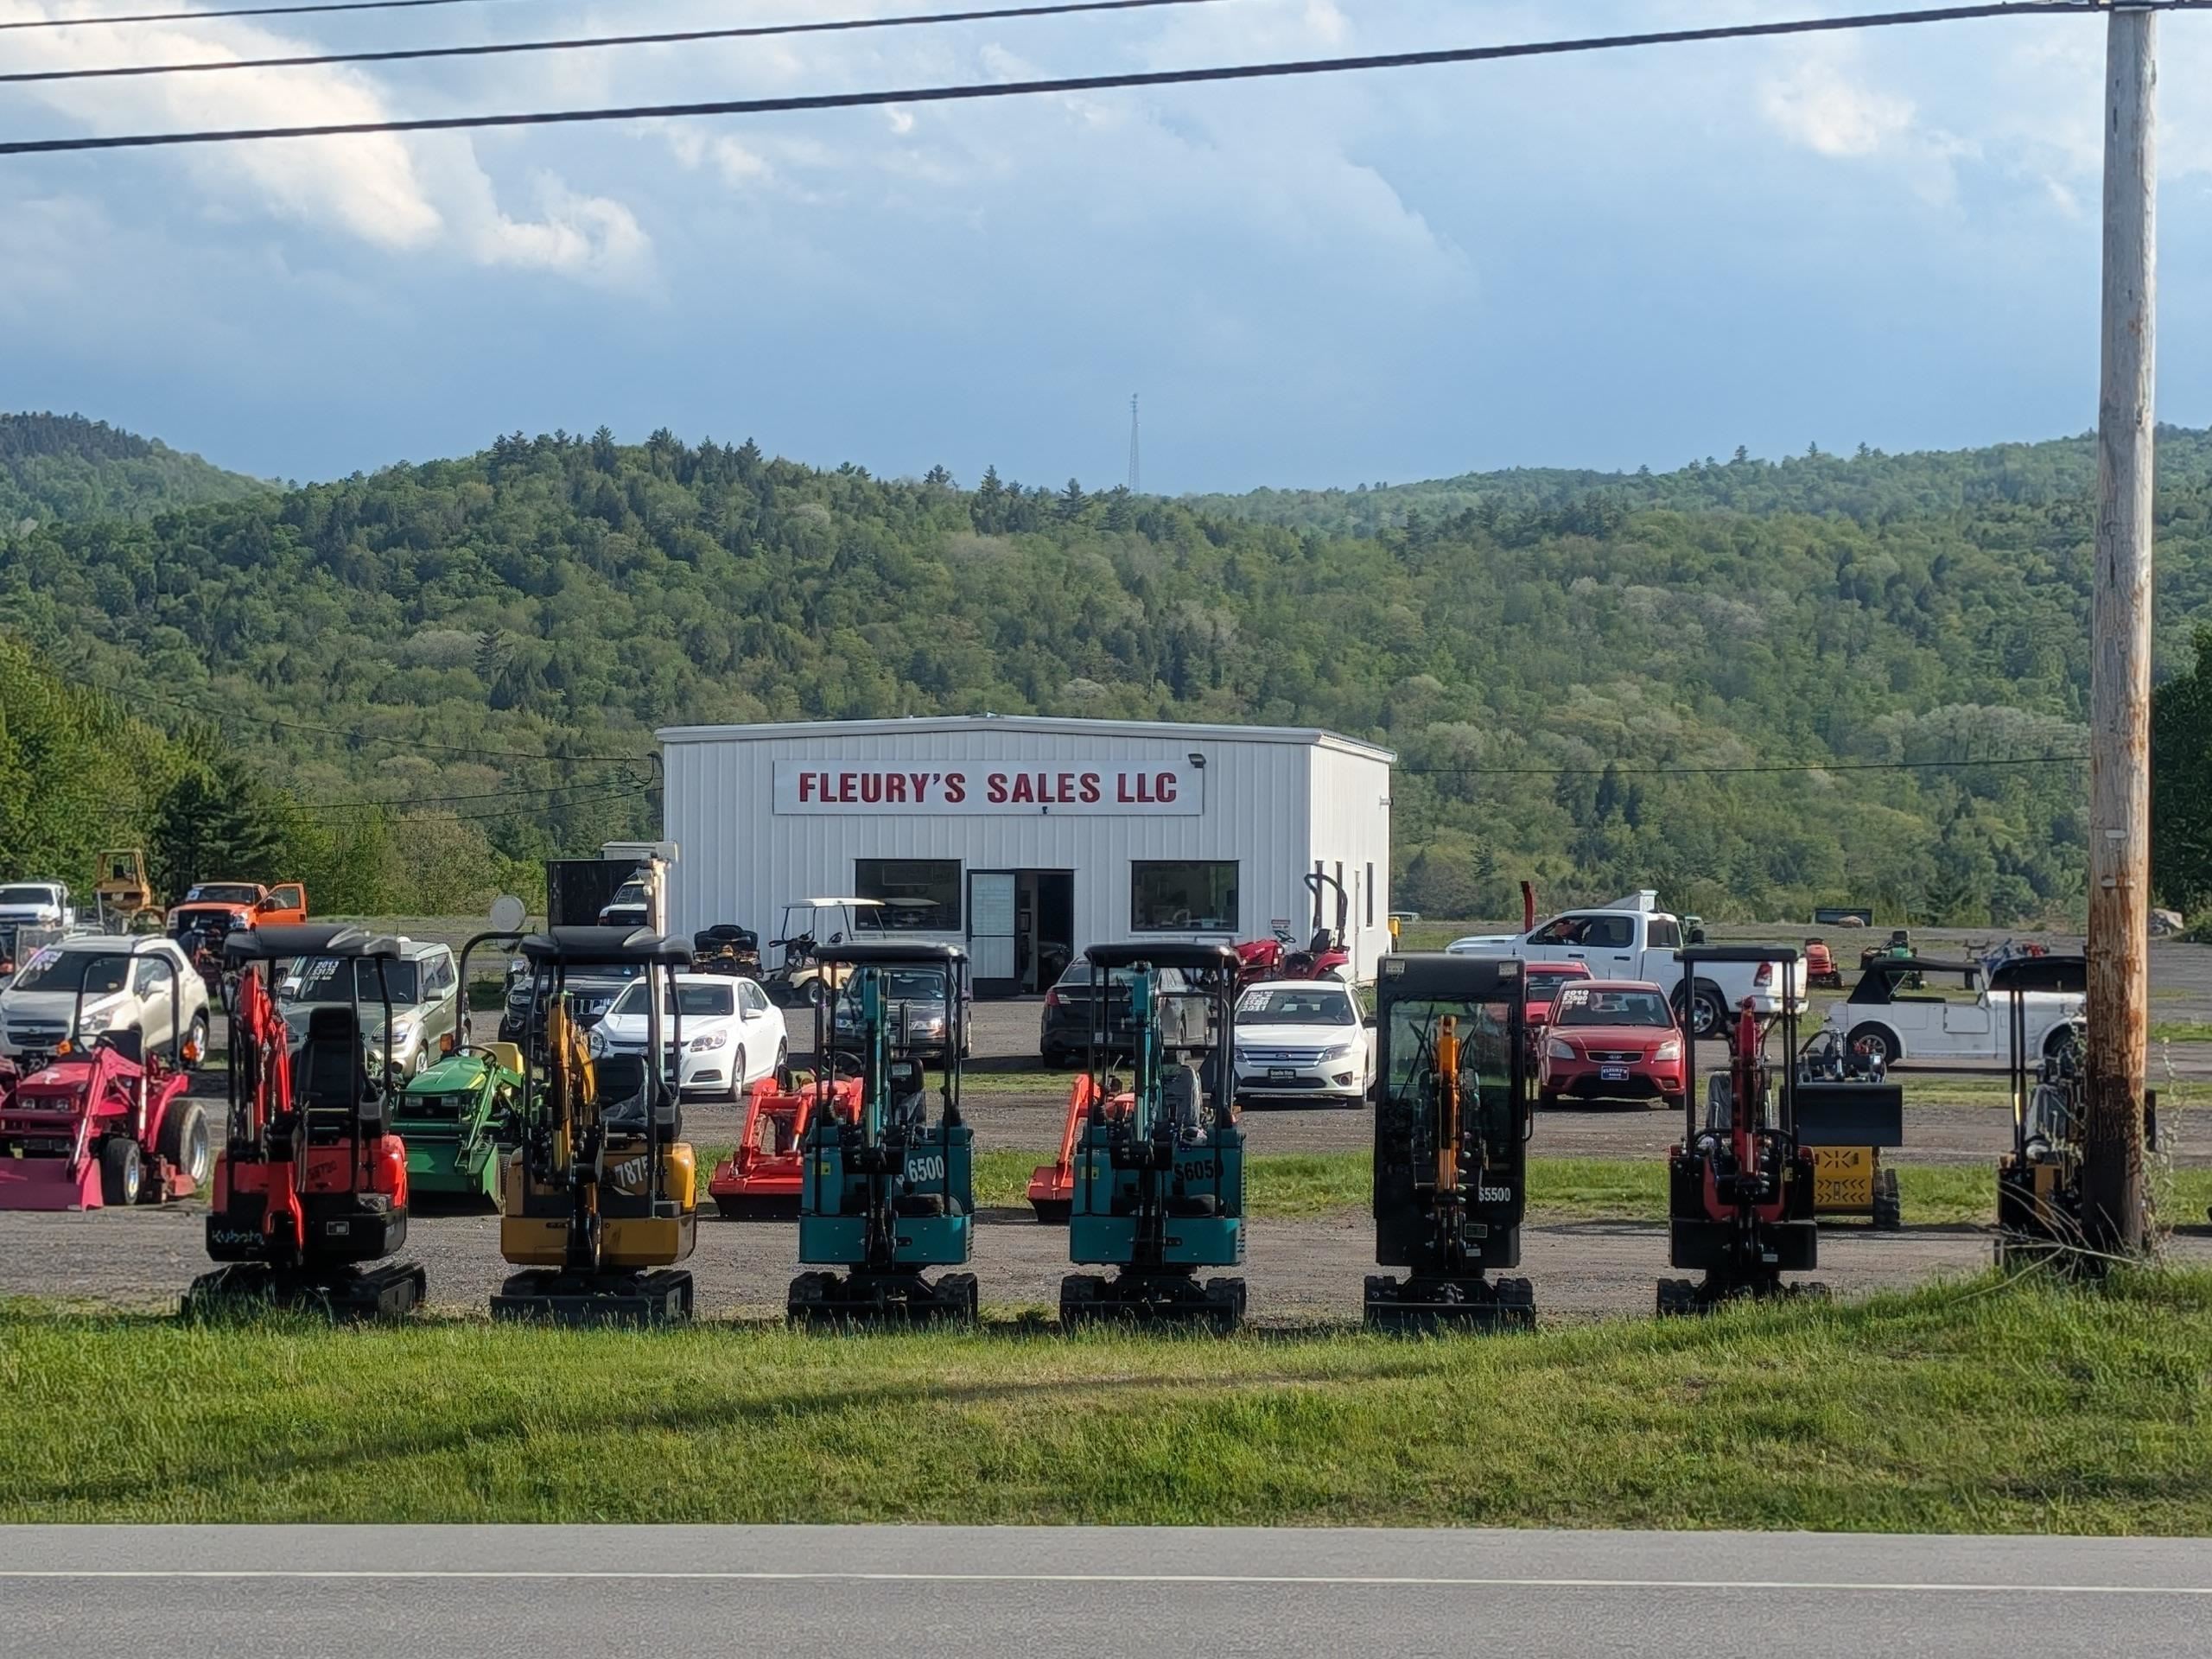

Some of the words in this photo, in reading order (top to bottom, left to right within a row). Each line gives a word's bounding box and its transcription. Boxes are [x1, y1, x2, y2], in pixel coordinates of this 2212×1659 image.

[798, 772, 966, 804] FLEURY'S
[987, 772, 1102, 804] SALES
[1117, 772, 1178, 804] LLC
[1478, 1186, 1511, 1203] $5500
